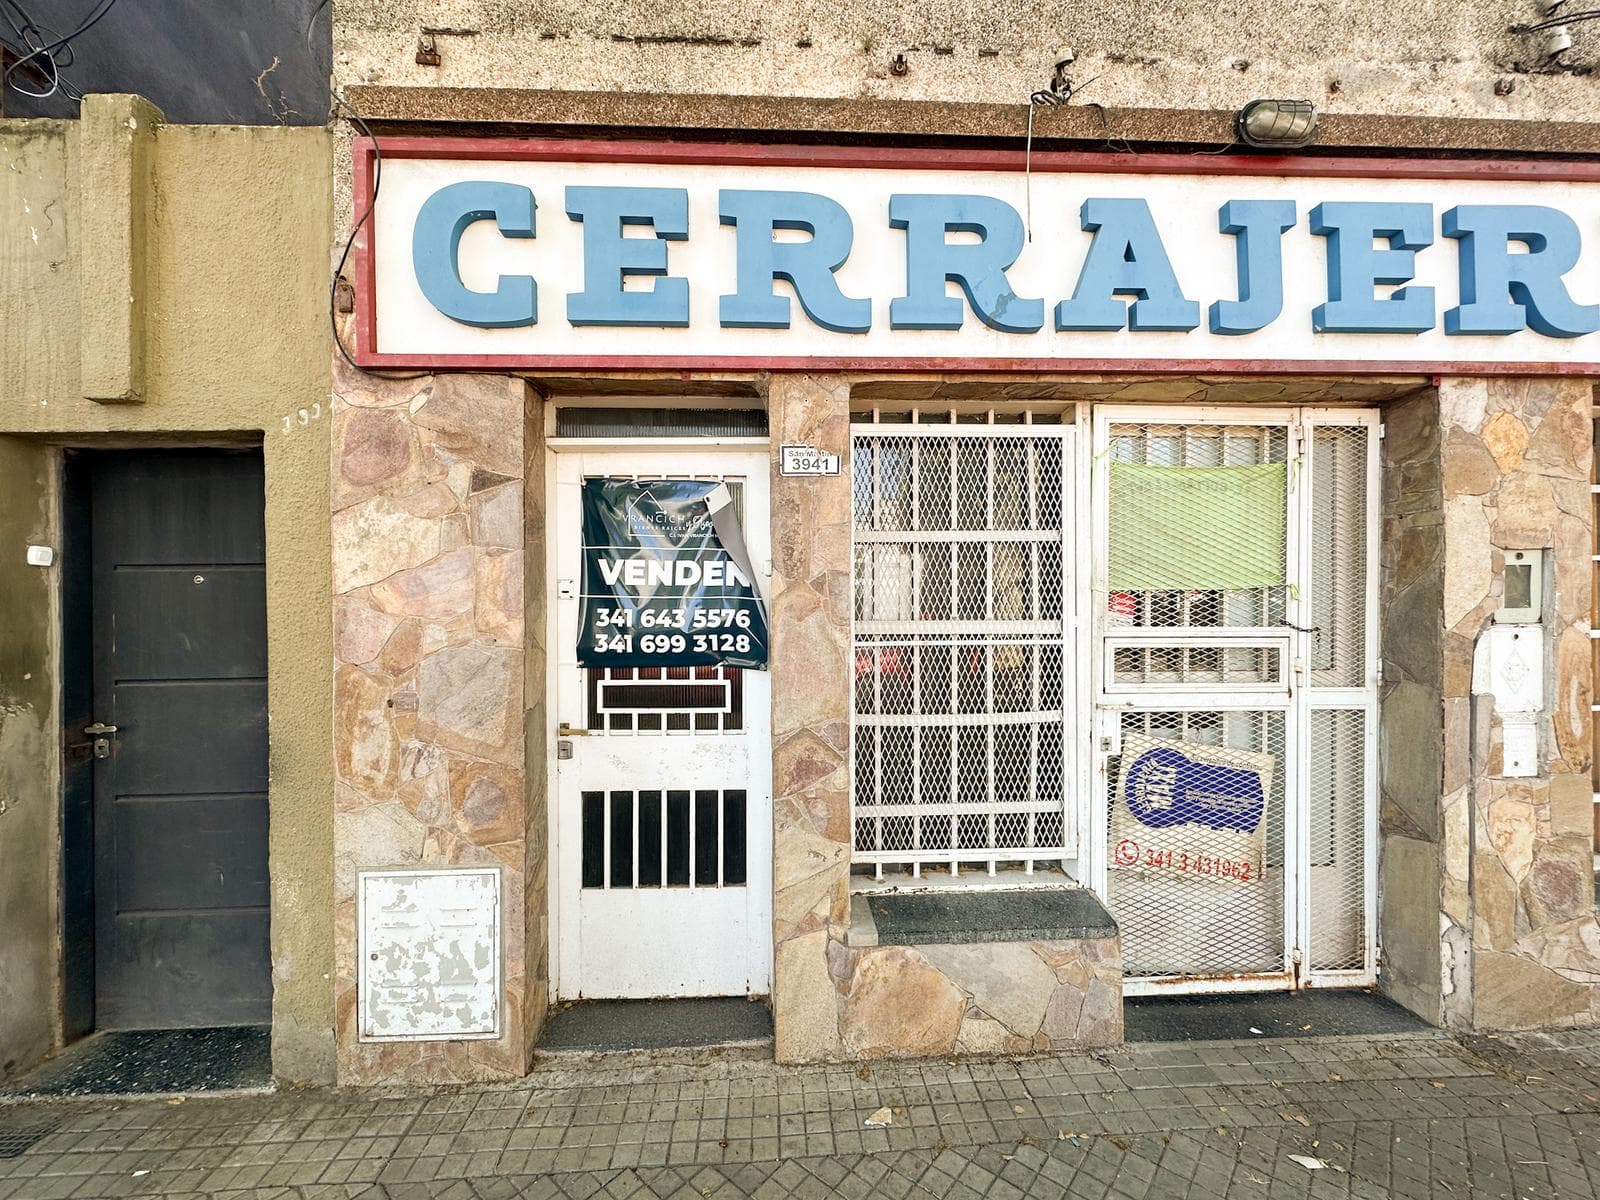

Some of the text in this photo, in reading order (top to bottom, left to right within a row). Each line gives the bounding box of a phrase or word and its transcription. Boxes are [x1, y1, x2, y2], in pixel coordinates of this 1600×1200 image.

[792, 458, 829, 470] 3941
[622, 514, 685, 524] VRANCICH
[596, 608, 750, 628] 341 643 5576
[594, 634, 750, 653] 341 699 3128
[1145, 849, 1251, 880] 341 3 431962
